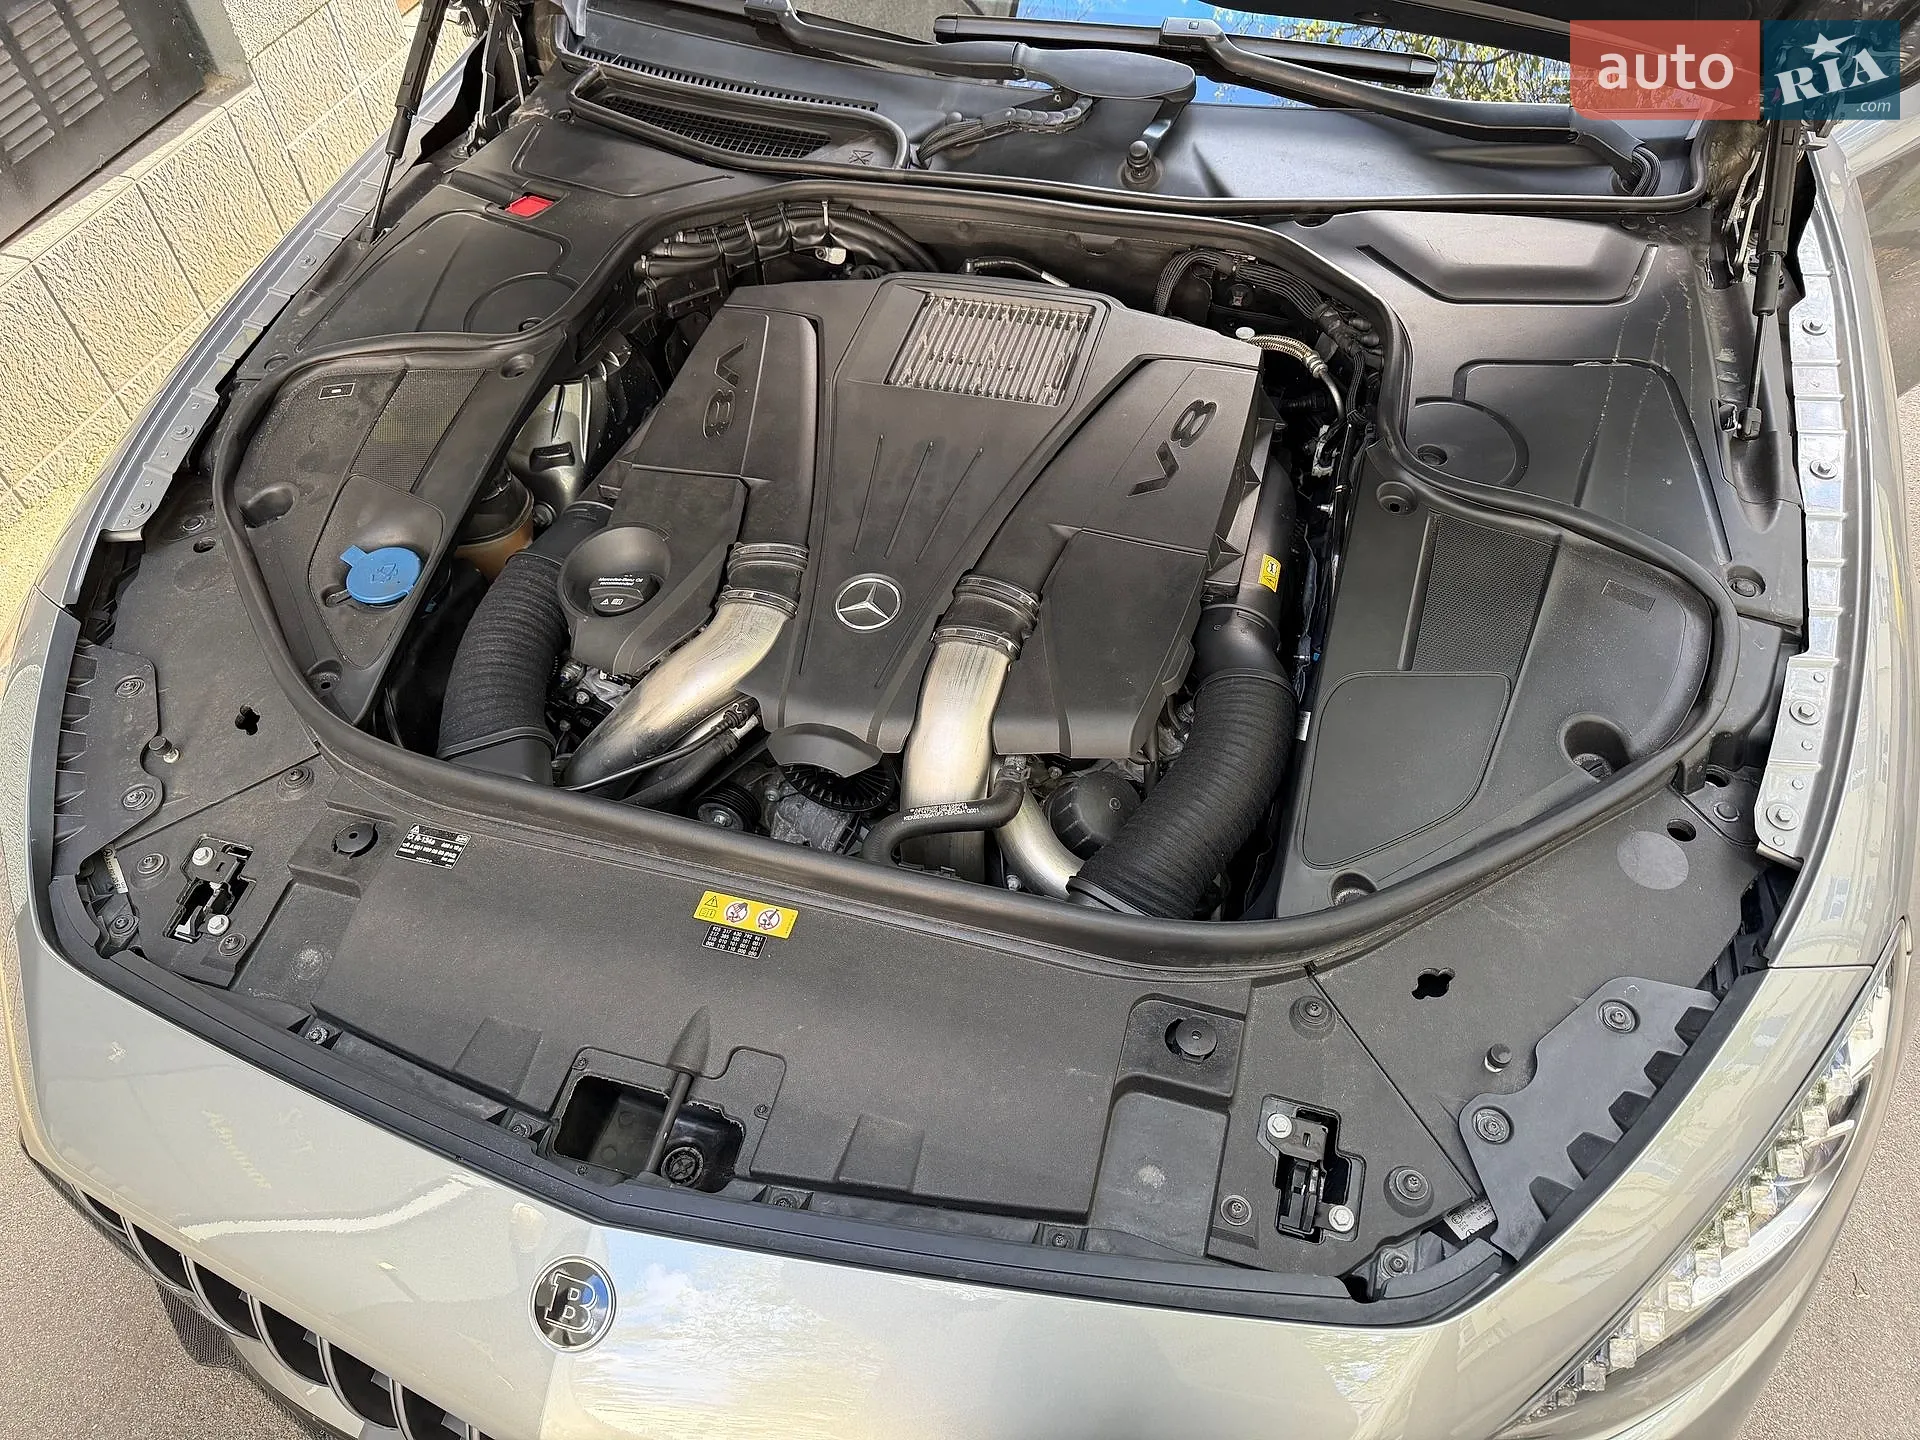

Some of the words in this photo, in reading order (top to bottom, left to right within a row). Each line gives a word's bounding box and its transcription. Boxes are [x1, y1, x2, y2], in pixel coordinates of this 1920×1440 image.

[703, 336, 748, 440] V8
[1126, 397, 1219, 498] V8
[543, 1269, 599, 1334] B
